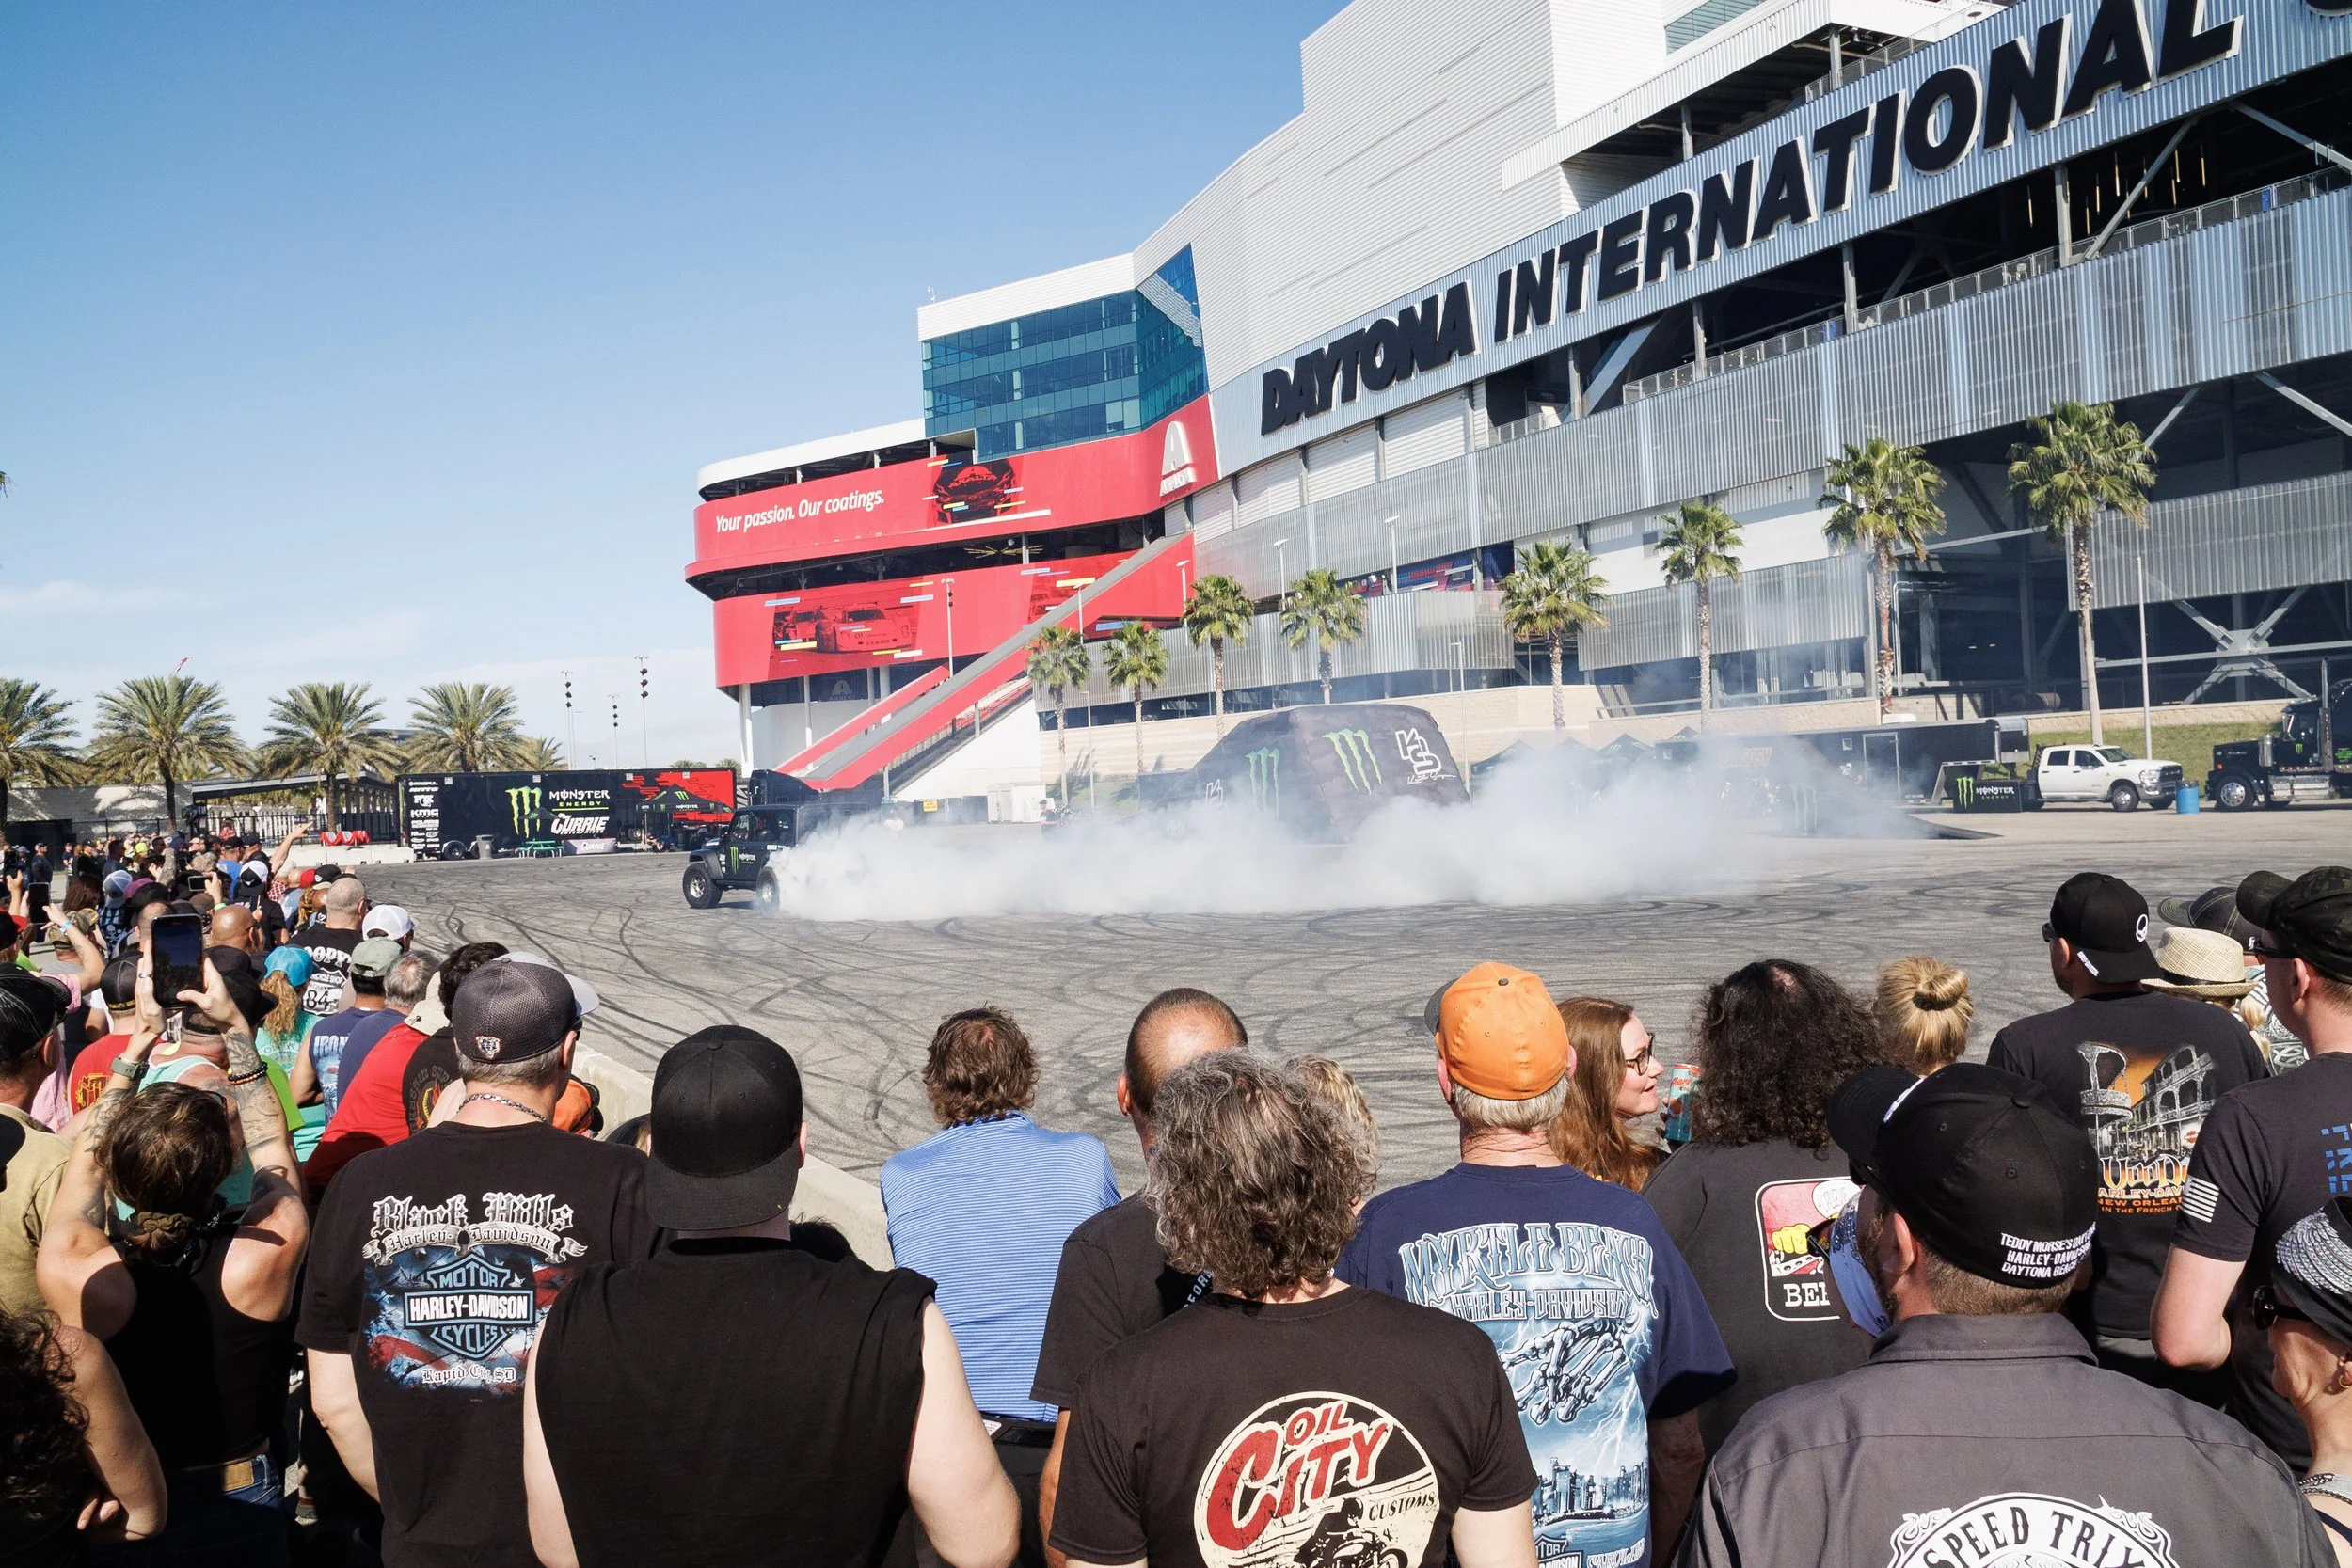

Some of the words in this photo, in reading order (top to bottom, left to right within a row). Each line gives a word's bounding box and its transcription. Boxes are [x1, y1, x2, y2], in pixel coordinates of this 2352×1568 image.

[1260, 280, 1479, 436] DAYTONA
[1494, 0, 2243, 344] INTERNATIONAL
[716, 515, 742, 532] Your
[743, 505, 796, 533] passion.
[798, 499, 823, 518] Our
[824, 490, 884, 512] coatings.
[548, 789, 611, 801] MONSTER
[1976, 785, 2015, 796] MONSTER
[550, 813, 611, 834] CURRIE
[2000, 1232, 2034, 1253] TEDDY
[439, 1261, 498, 1288] MOTOR
[1398, 1223, 1555, 1305] MYRTLE
[1554, 1223, 1659, 1319] BEACH
[2001, 1261, 2052, 1278] DAYTONA
[409, 1294, 529, 1322] HARLEY-DAVIDSON
[441, 1324, 498, 1353] CYCLES
[1285, 1402, 1351, 1447] OIL
[1205, 1420, 1391, 1552] CITY
[1368, 1491, 1438, 1522] CUSTOMS
[1923, 1506, 2030, 1568] SPEED
